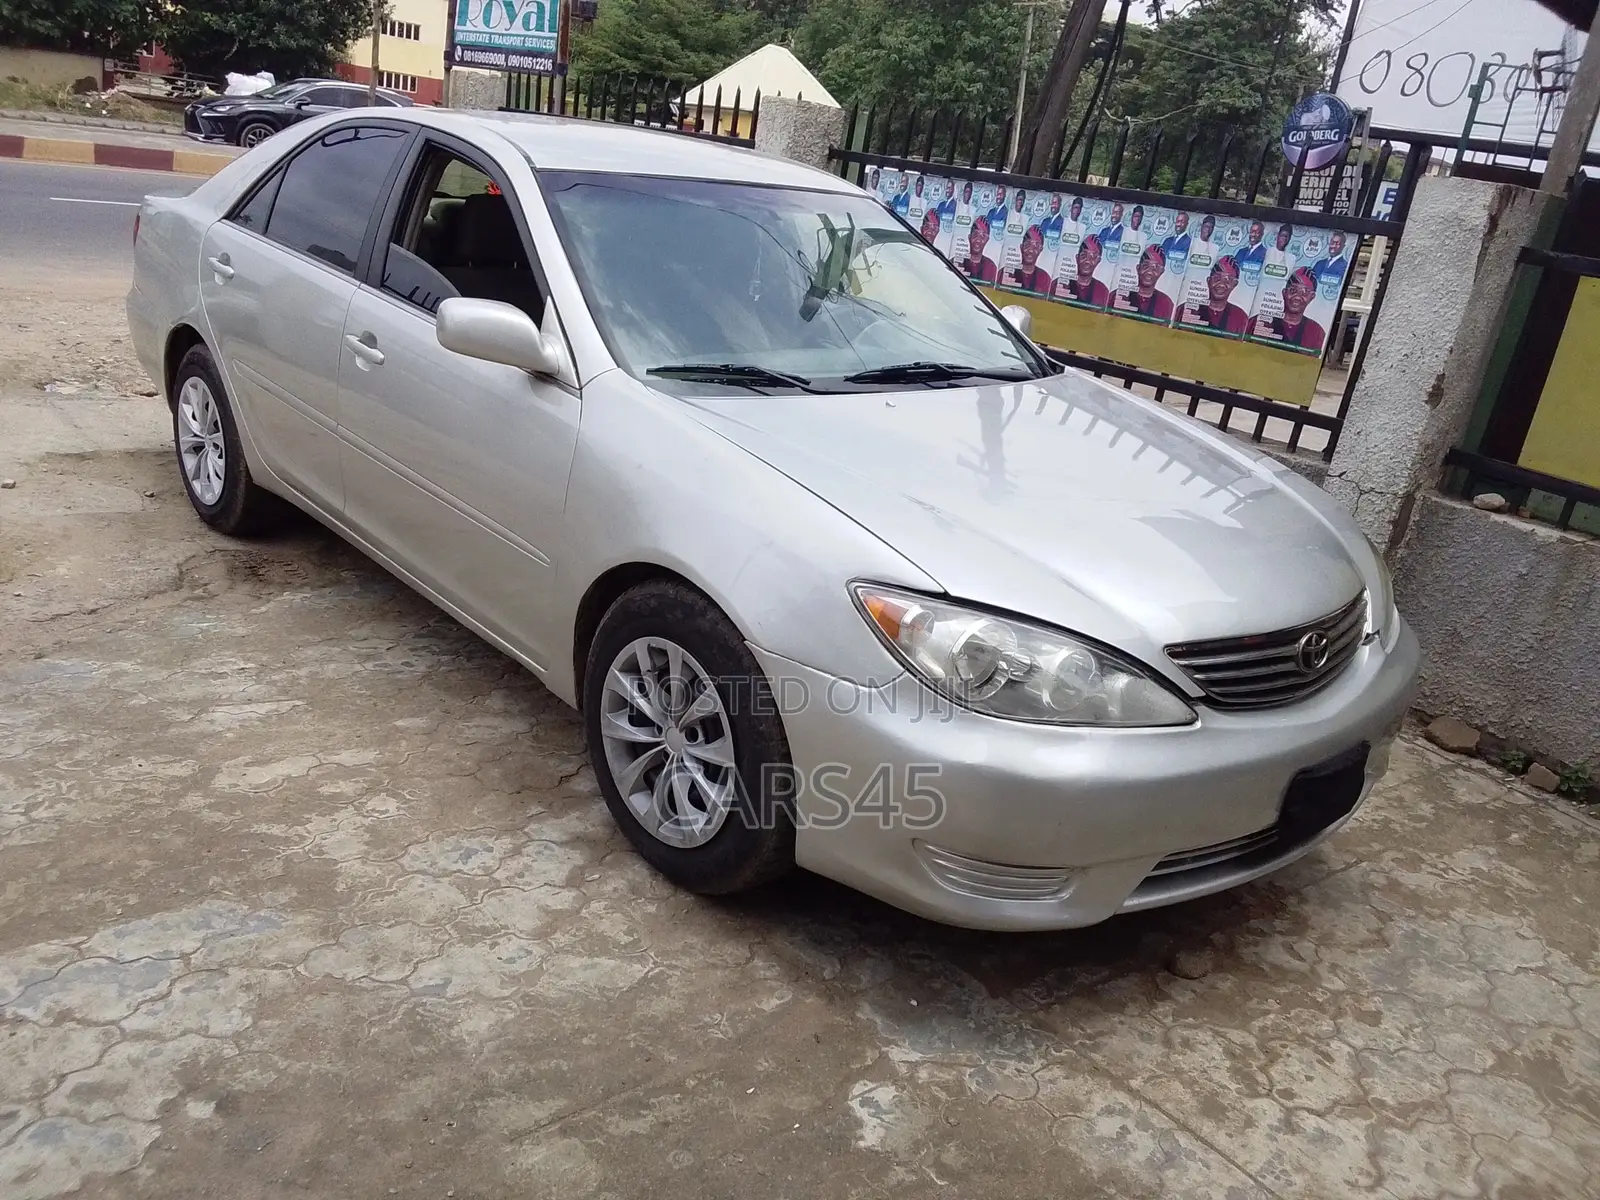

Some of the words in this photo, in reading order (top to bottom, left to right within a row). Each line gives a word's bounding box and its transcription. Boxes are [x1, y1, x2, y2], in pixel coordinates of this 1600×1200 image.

[456, 0, 558, 32] Royal
[491, 35, 524, 46] TRANSPORT
[525, 38, 556, 51] SERVICES)
